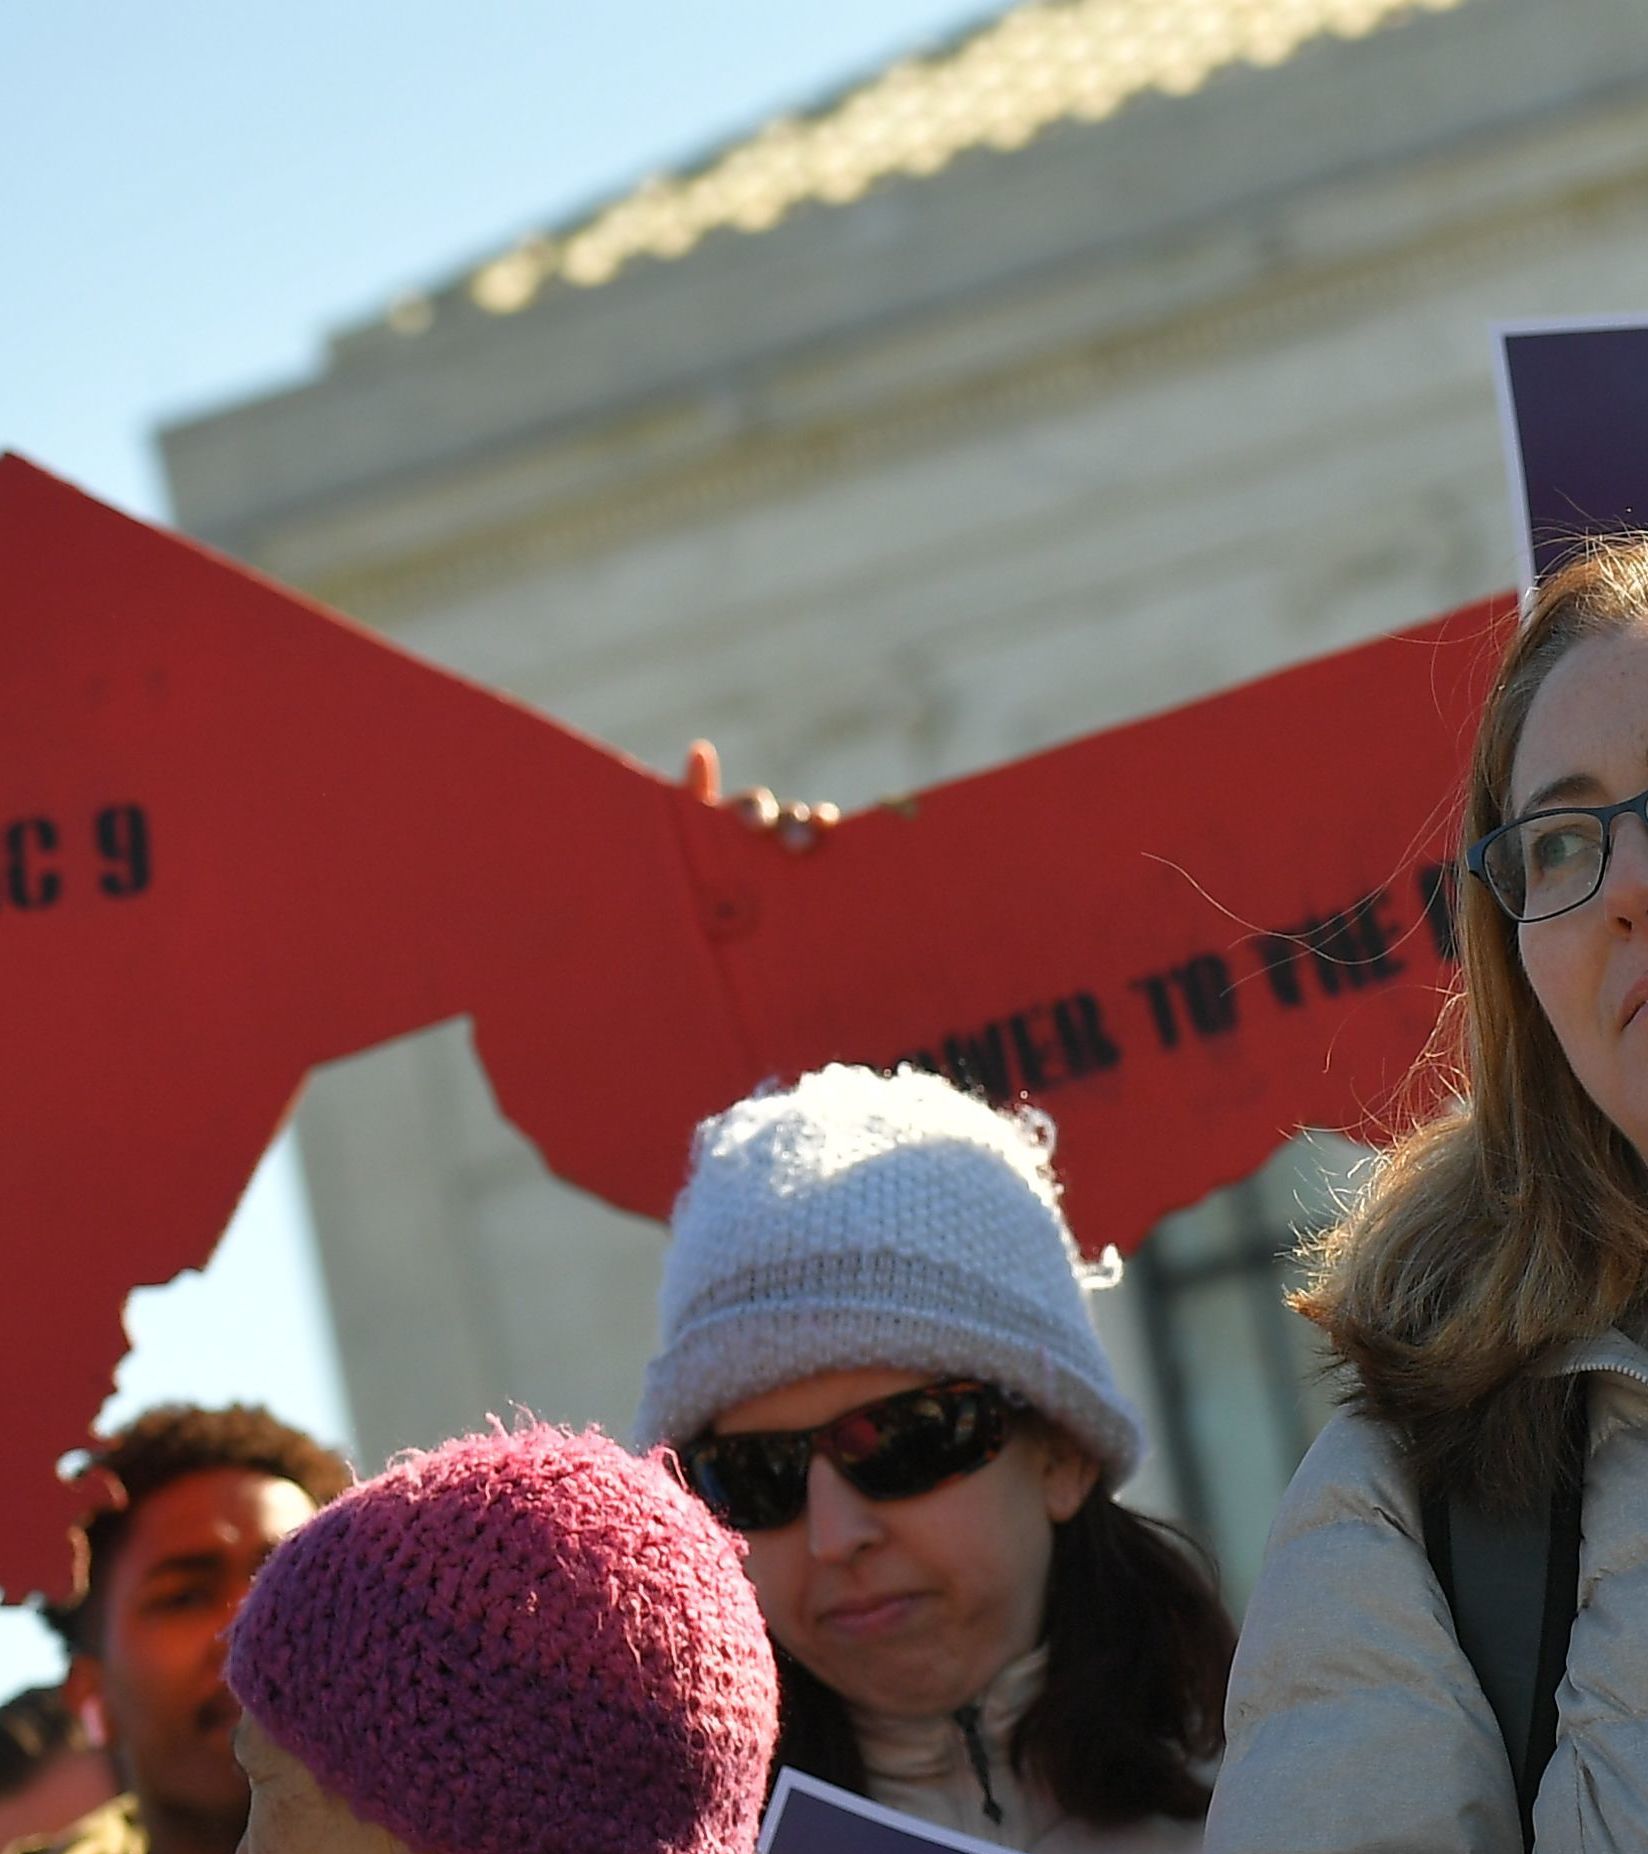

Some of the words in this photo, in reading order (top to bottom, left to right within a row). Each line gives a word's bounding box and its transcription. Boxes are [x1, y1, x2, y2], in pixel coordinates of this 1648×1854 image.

[97, 803, 151, 896] 9
[893, 991, 1121, 1104] WER
[1128, 950, 1239, 1050] TO
